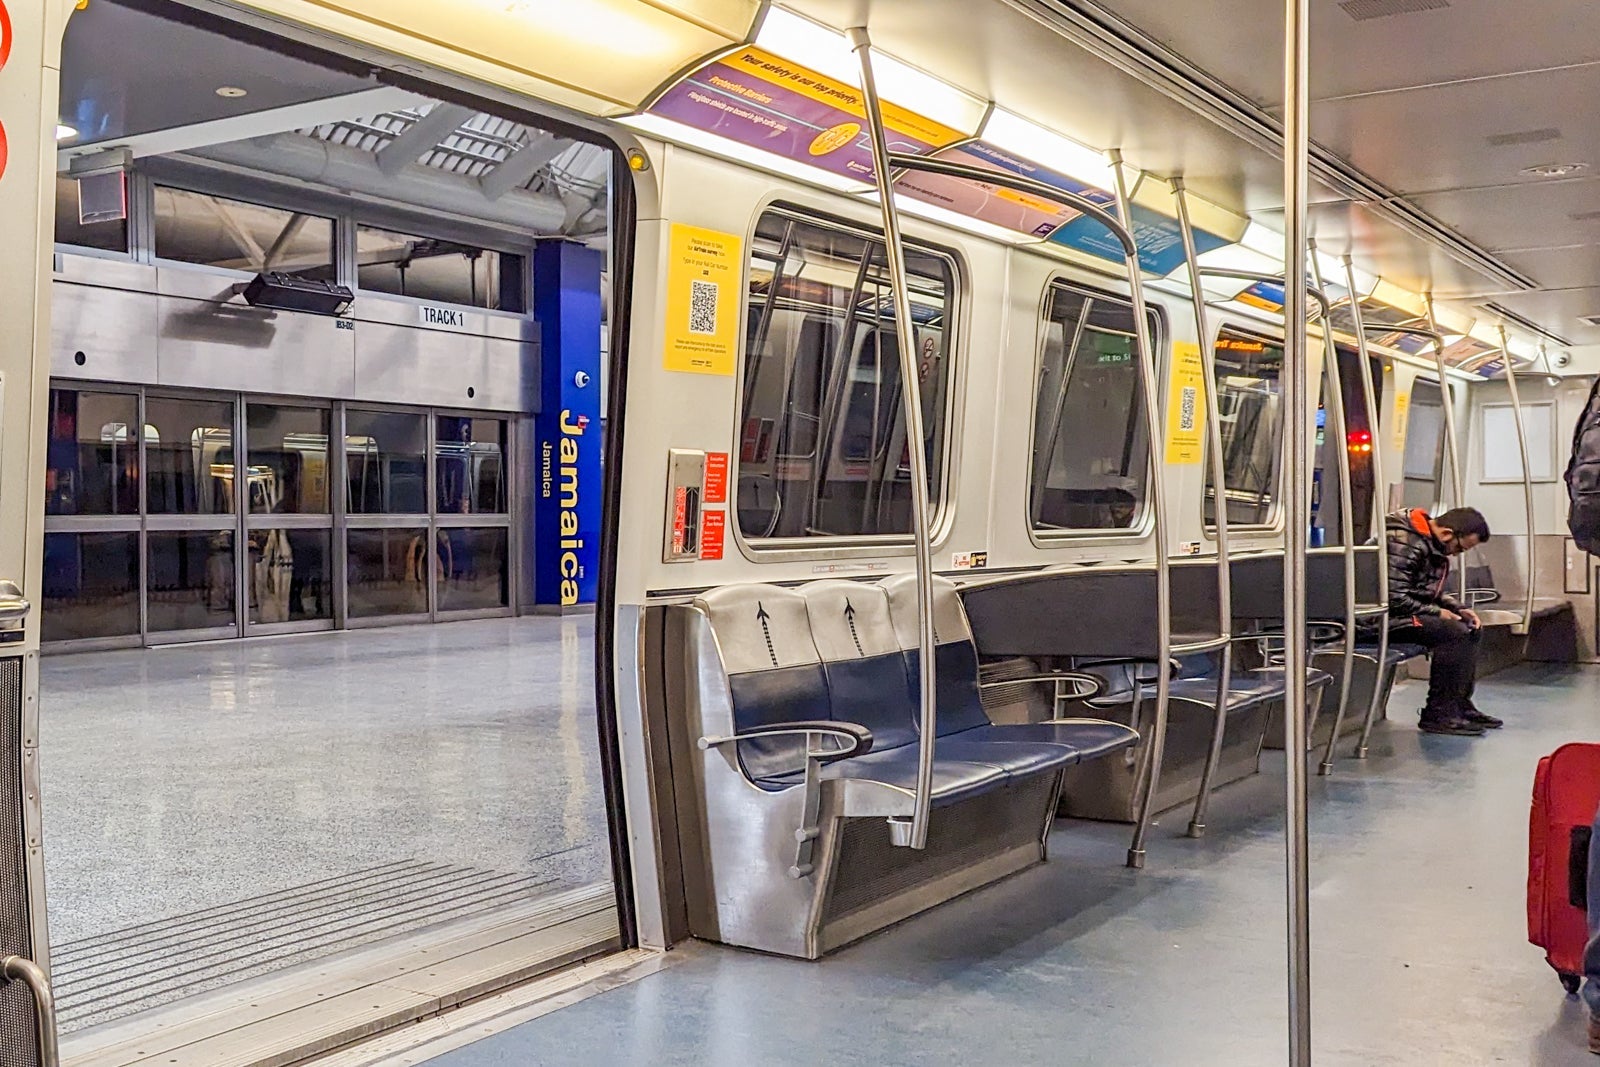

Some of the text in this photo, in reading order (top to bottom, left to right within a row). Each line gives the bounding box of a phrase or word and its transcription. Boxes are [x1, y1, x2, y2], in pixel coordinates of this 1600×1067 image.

[708, 76, 772, 104] Protective Barriers
[741, 53, 763, 66] Your
[761, 61, 790, 78] safety
[798, 77, 815, 86] our
[813, 82, 827, 92] top
[424, 307, 463, 326] TRACK 1
[542, 441, 552, 498] Jamaica
[560, 409, 584, 606] Jamaica
